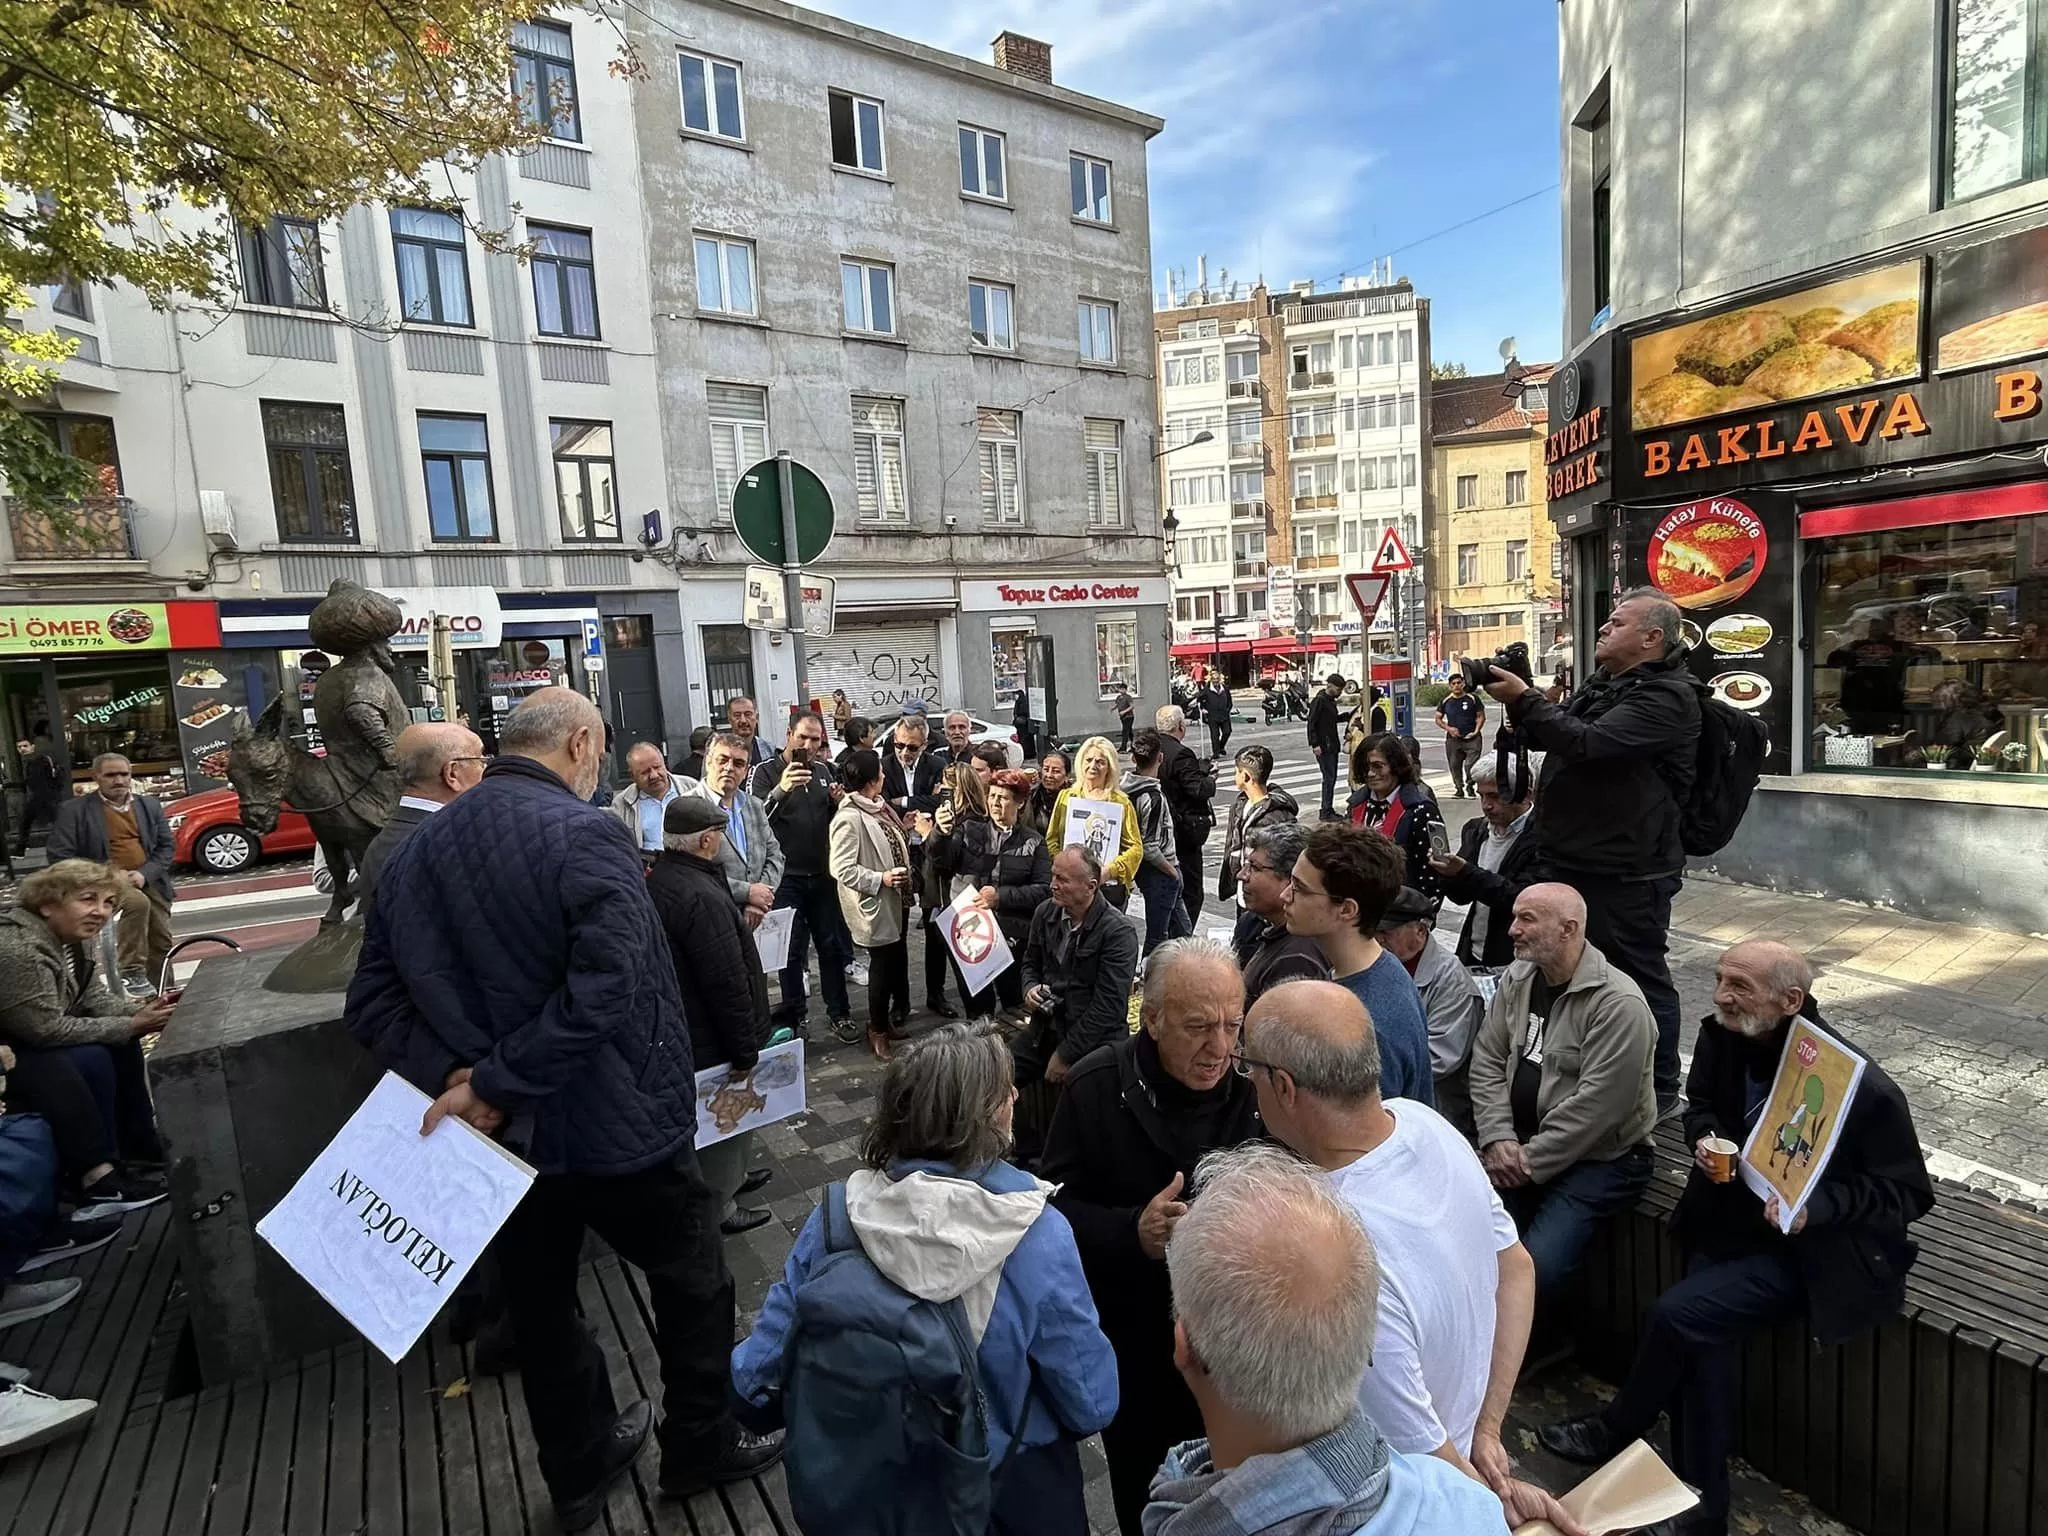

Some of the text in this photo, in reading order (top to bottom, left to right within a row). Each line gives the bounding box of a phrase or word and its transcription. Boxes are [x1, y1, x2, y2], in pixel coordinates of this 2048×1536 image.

[1544, 407, 1600, 466] LEVENT
[1644, 392, 1929, 477] BAKLAVA
[1655, 500, 1761, 542] Hatay Künefe
[997, 583, 1140, 605] Topuz Cado Center
[25, 617, 101, 637] ÖMER
[30, 637, 104, 647] 0493 85 77 76
[585, 623, 597, 650] P
[73, 687, 160, 724] Vegetarian
[1796, 1040, 1818, 1062] STOP
[329, 1168, 457, 1287] KELOĞLAN
